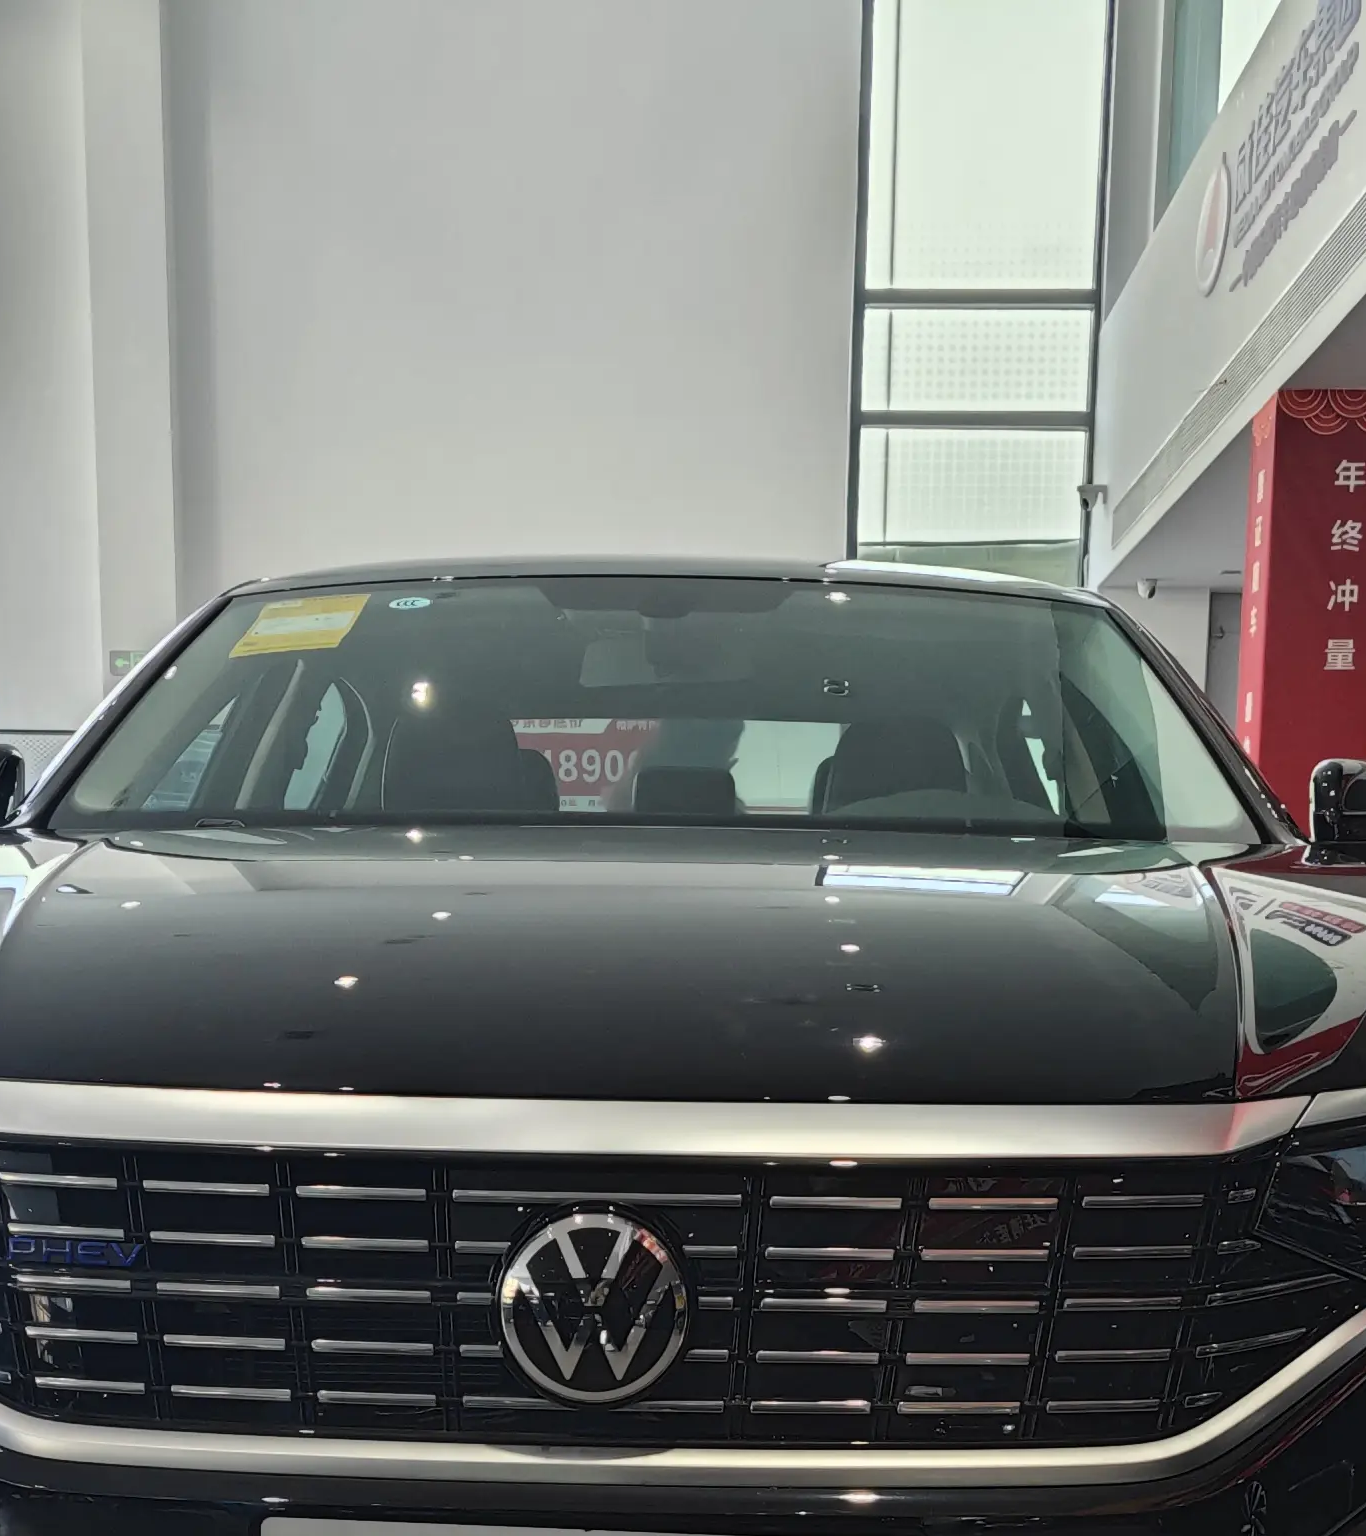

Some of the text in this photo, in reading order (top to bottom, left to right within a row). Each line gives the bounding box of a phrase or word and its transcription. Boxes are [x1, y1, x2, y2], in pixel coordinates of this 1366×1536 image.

[1323, 459, 1366, 671] 年终冲量
[8, 1236, 144, 1266] PHEV
